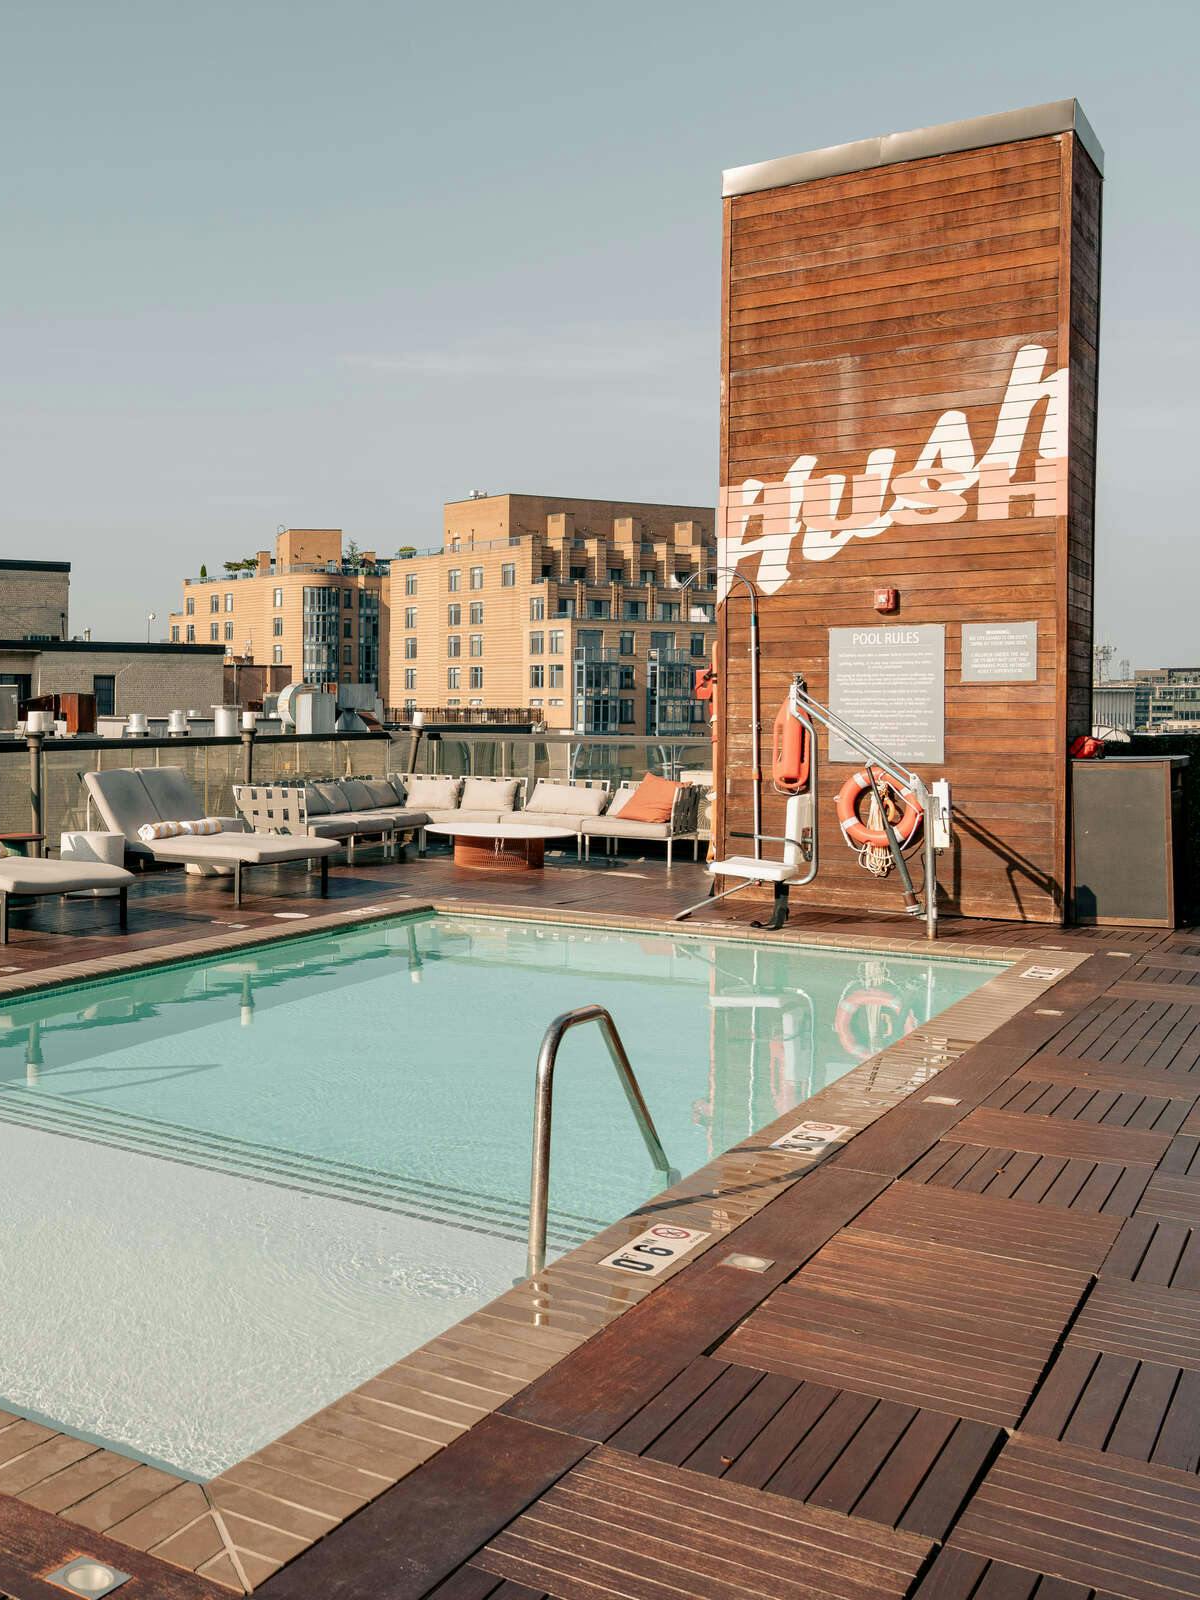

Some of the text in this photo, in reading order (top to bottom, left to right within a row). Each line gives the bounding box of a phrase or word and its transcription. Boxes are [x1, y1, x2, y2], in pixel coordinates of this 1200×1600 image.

[717, 457, 1069, 538] HUSH
[852, 631, 920, 645] POOL RULES
[632, 1244, 674, 1257] 6
[612, 1258, 654, 1271] 0
